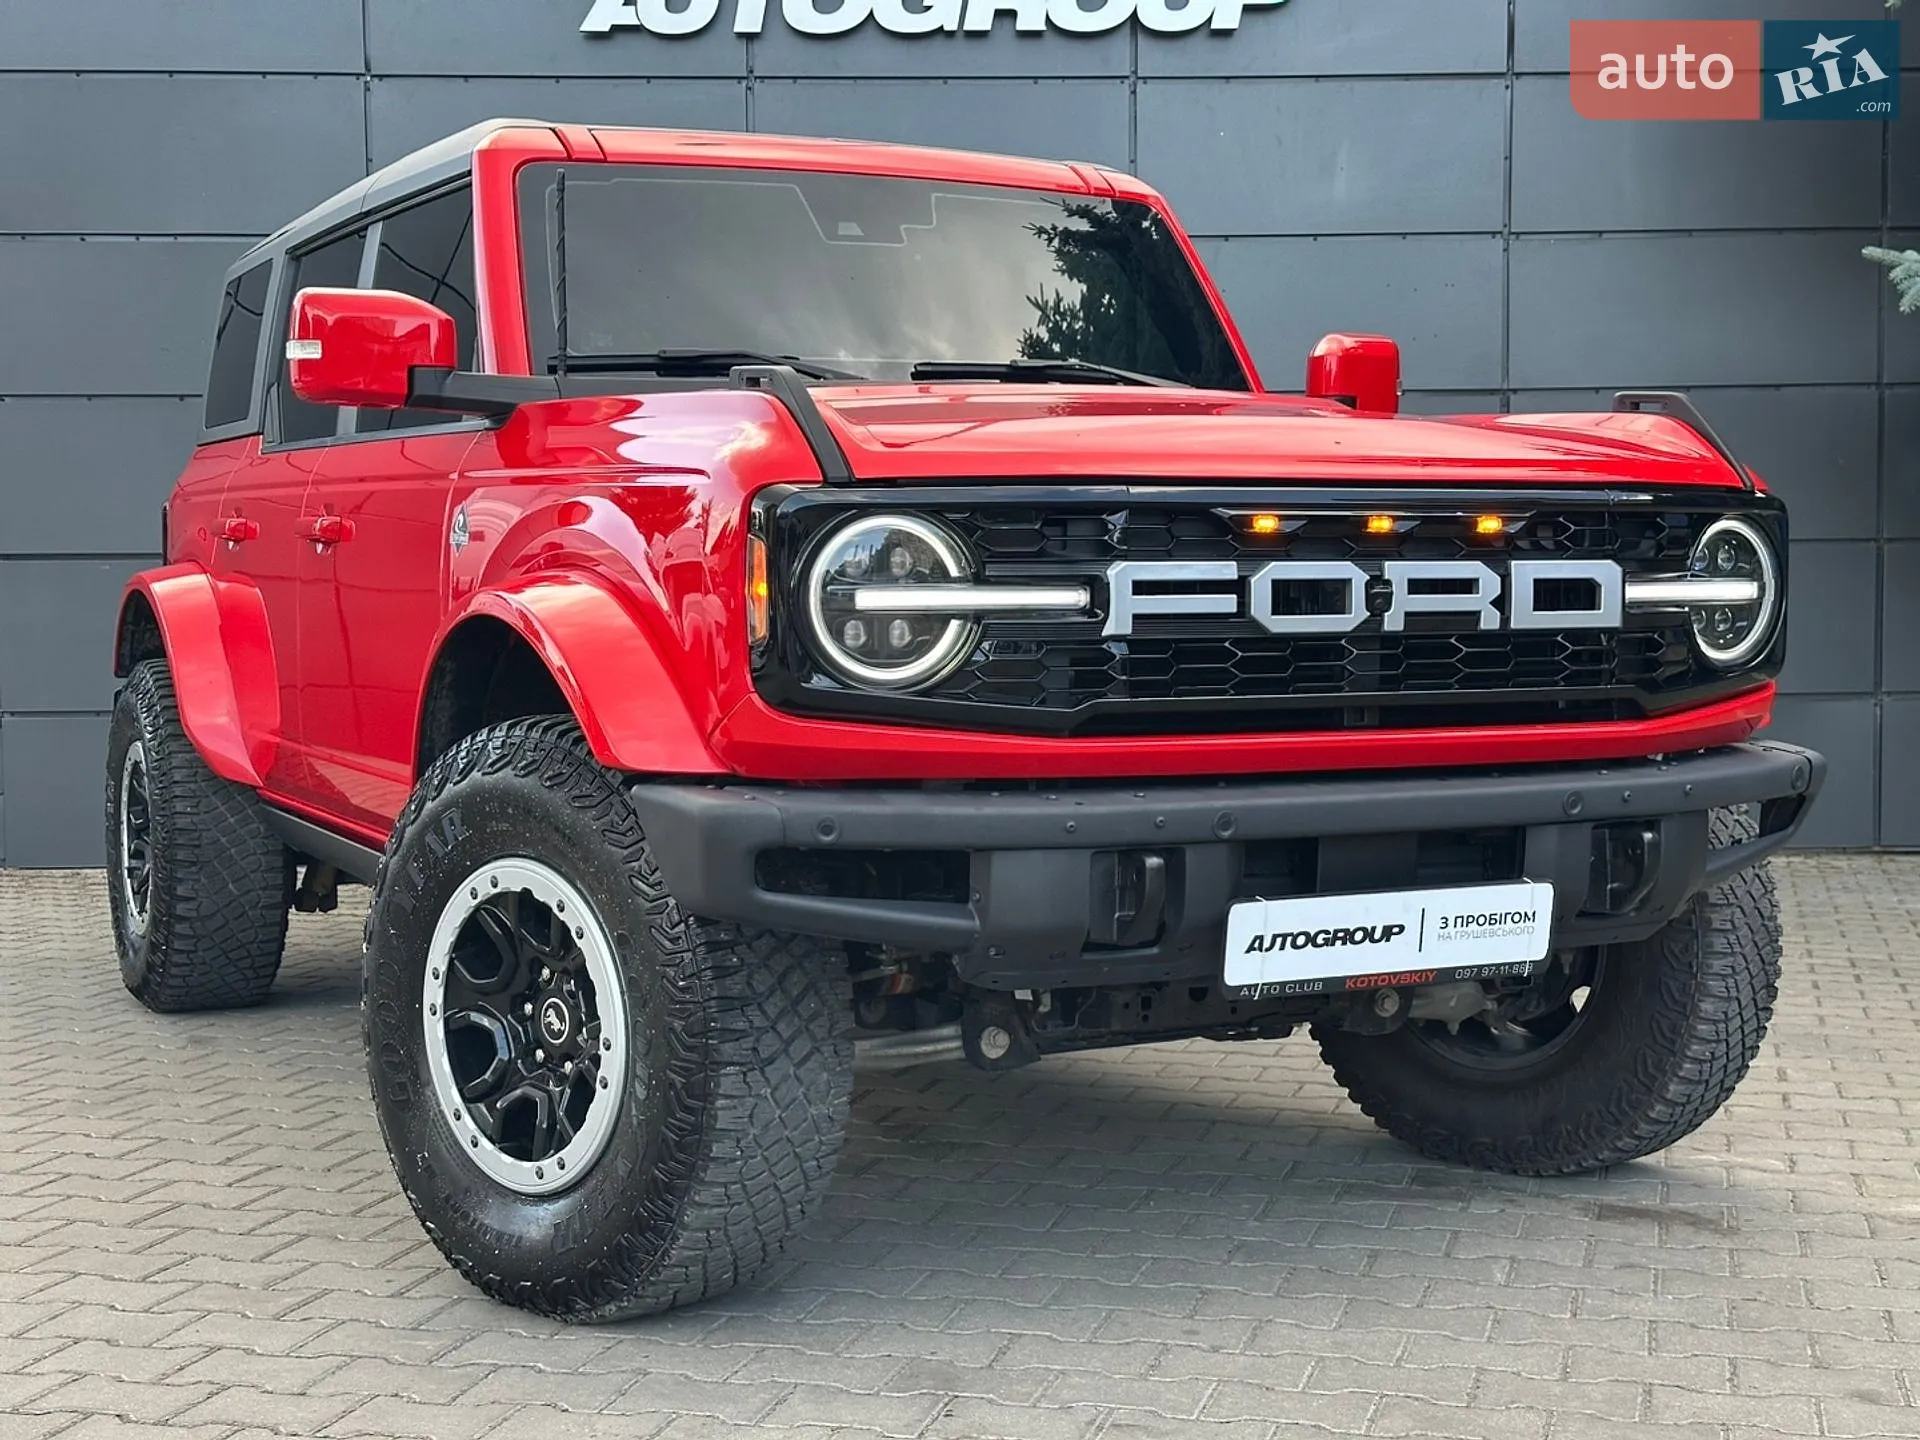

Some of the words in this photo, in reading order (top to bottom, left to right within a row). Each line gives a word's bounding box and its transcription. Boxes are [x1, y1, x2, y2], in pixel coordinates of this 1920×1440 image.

[1101, 560, 1623, 635] FORD
[1437, 931, 1452, 941] НА
[1454, 925, 1535, 940] ГРУШЕВСЬКОГО
[1439, 916, 1449, 930] З
[1453, 910, 1536, 928] ПРОБІГОМ
[1244, 924, 1406, 954] AUTOGROUP
[1285, 981, 1323, 994] CLUB
[1345, 970, 1437, 990] KOTOVSKIY
[1454, 967, 1478, 979] 097
